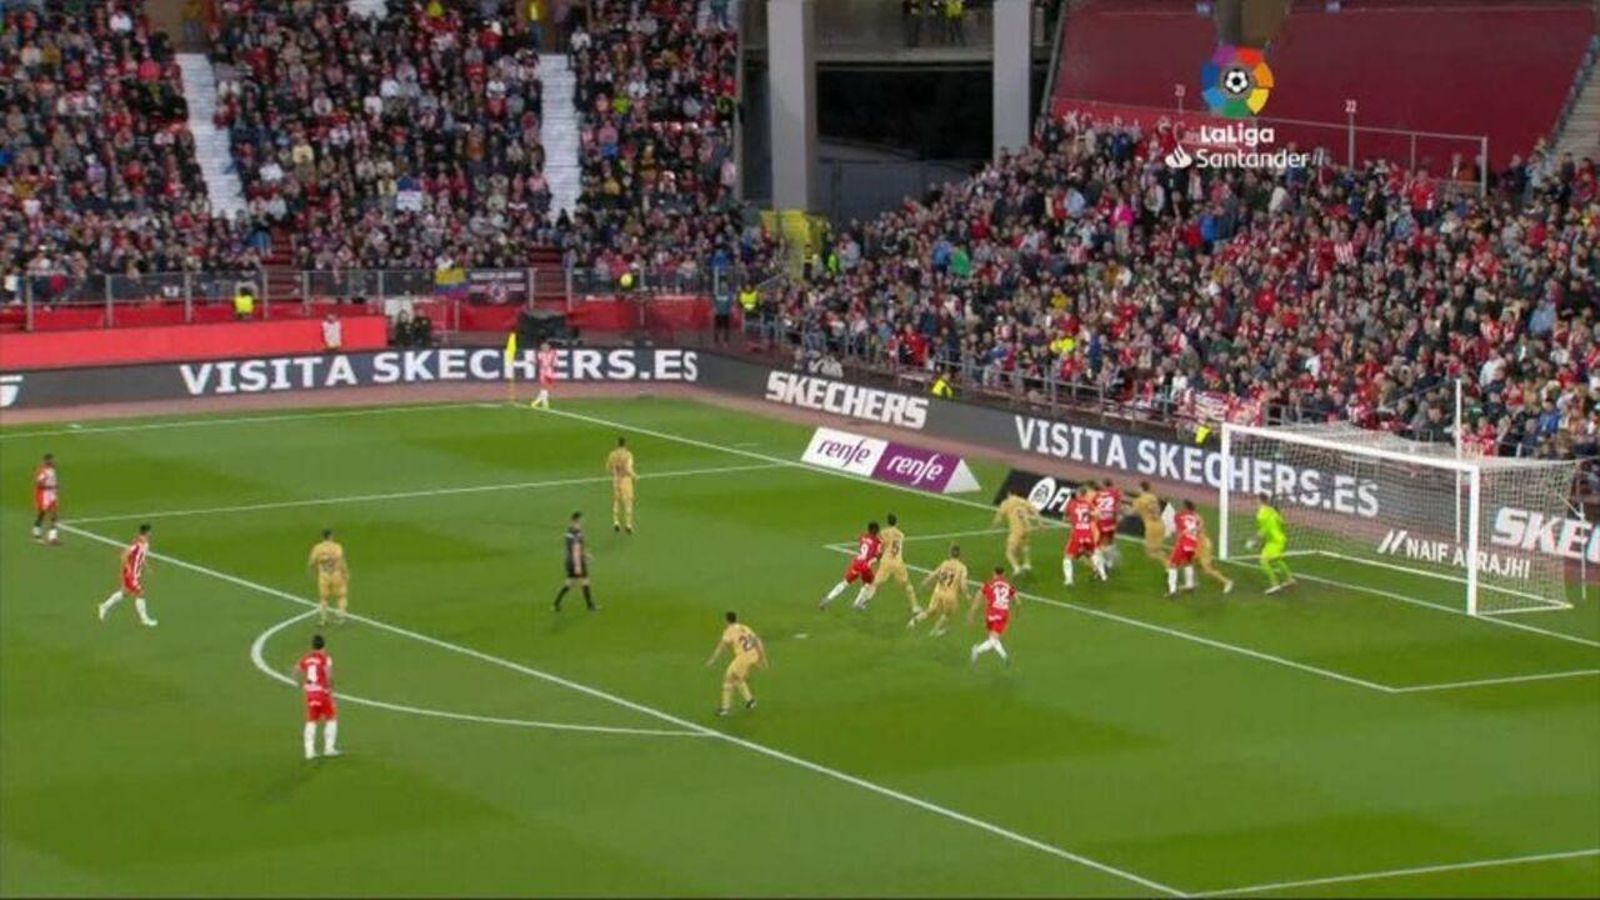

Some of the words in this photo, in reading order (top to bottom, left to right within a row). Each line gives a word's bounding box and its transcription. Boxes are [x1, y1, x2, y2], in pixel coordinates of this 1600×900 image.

[180, 355, 357, 395] VISITA
[372, 348, 698, 383] SKECHERS.ES
[765, 370, 929, 430] SKECHERS
[817, 439, 871, 468] renfe
[887, 453, 944, 485] renfe
[1015, 415, 1127, 470] VISITA
[1136, 440, 1379, 518] SKECHERS.ES
[1405, 538, 1449, 563] NAIF
[1491, 506, 1600, 563] SKE
[993, 585, 1010, 602] 12
